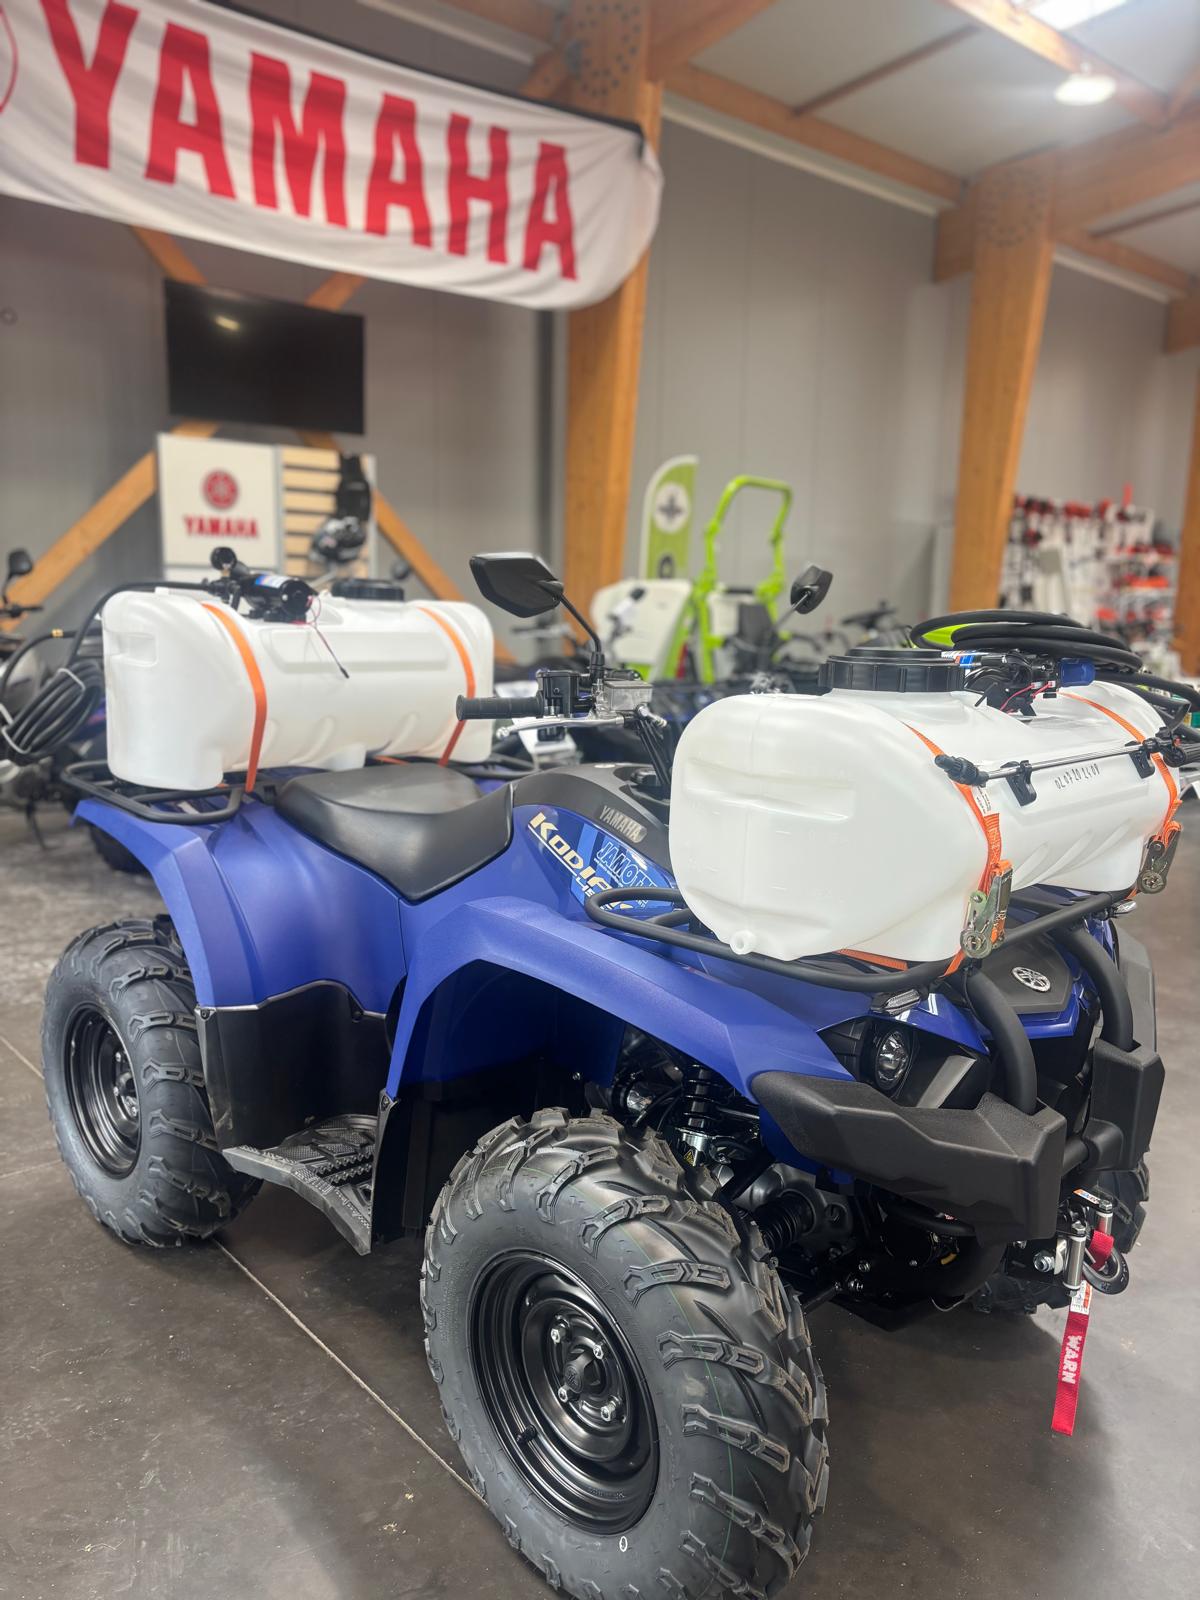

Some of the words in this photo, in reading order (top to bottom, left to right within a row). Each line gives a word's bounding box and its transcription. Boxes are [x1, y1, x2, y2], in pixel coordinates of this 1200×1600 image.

[38, 0, 578, 281] YAMAHA
[183, 515, 259, 539] YAMAHA
[599, 805, 645, 843] YAMAHA
[1061, 1334, 1083, 1385] WARN
